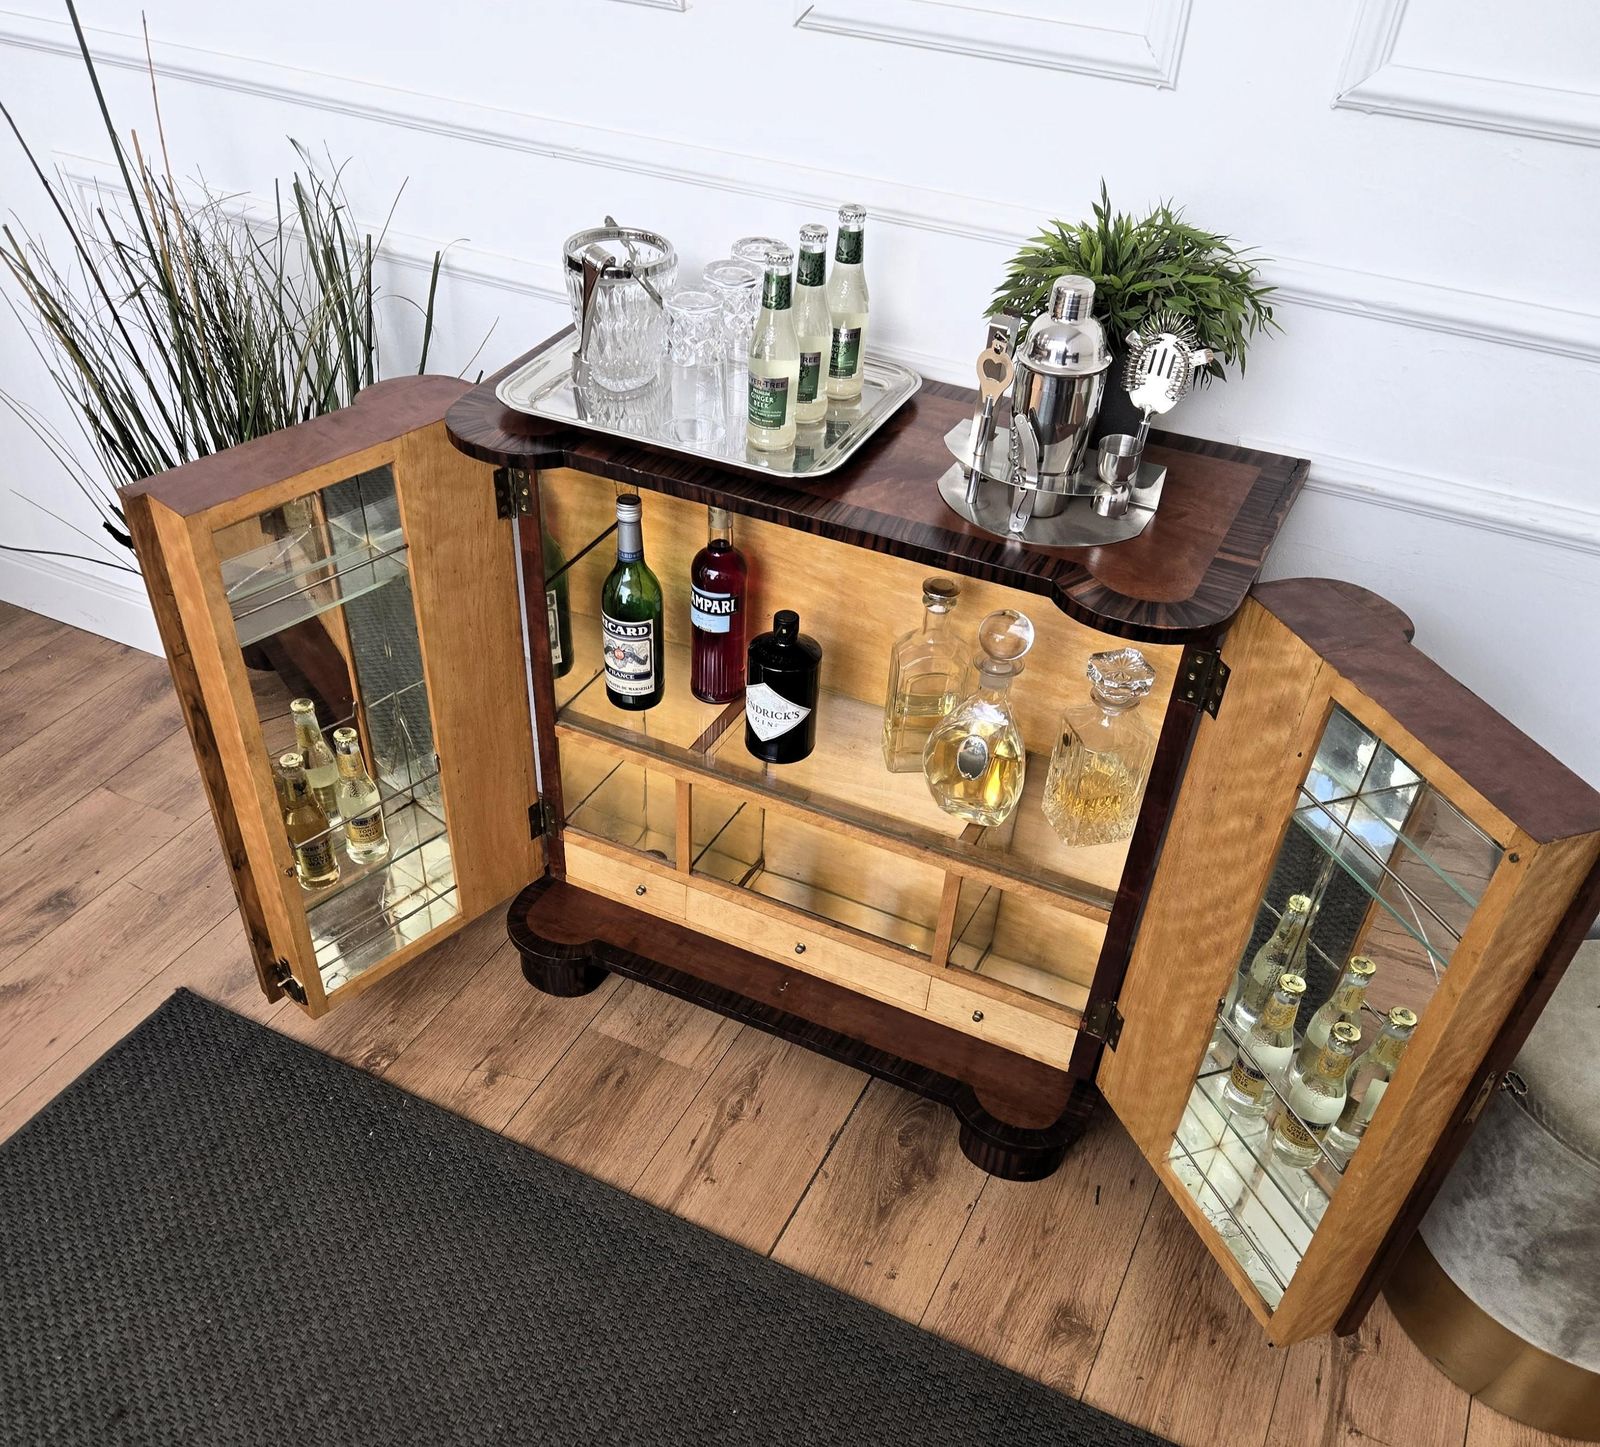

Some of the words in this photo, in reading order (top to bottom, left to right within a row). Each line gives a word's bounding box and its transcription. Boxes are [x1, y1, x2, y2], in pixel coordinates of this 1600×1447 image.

[691, 590, 735, 614] AMPARI
[608, 667, 635, 680] FRANCE
[754, 716, 774, 728] GIN
[1286, 1123, 1309, 1138] TONIC
[1286, 1127, 1309, 1142] WATER
